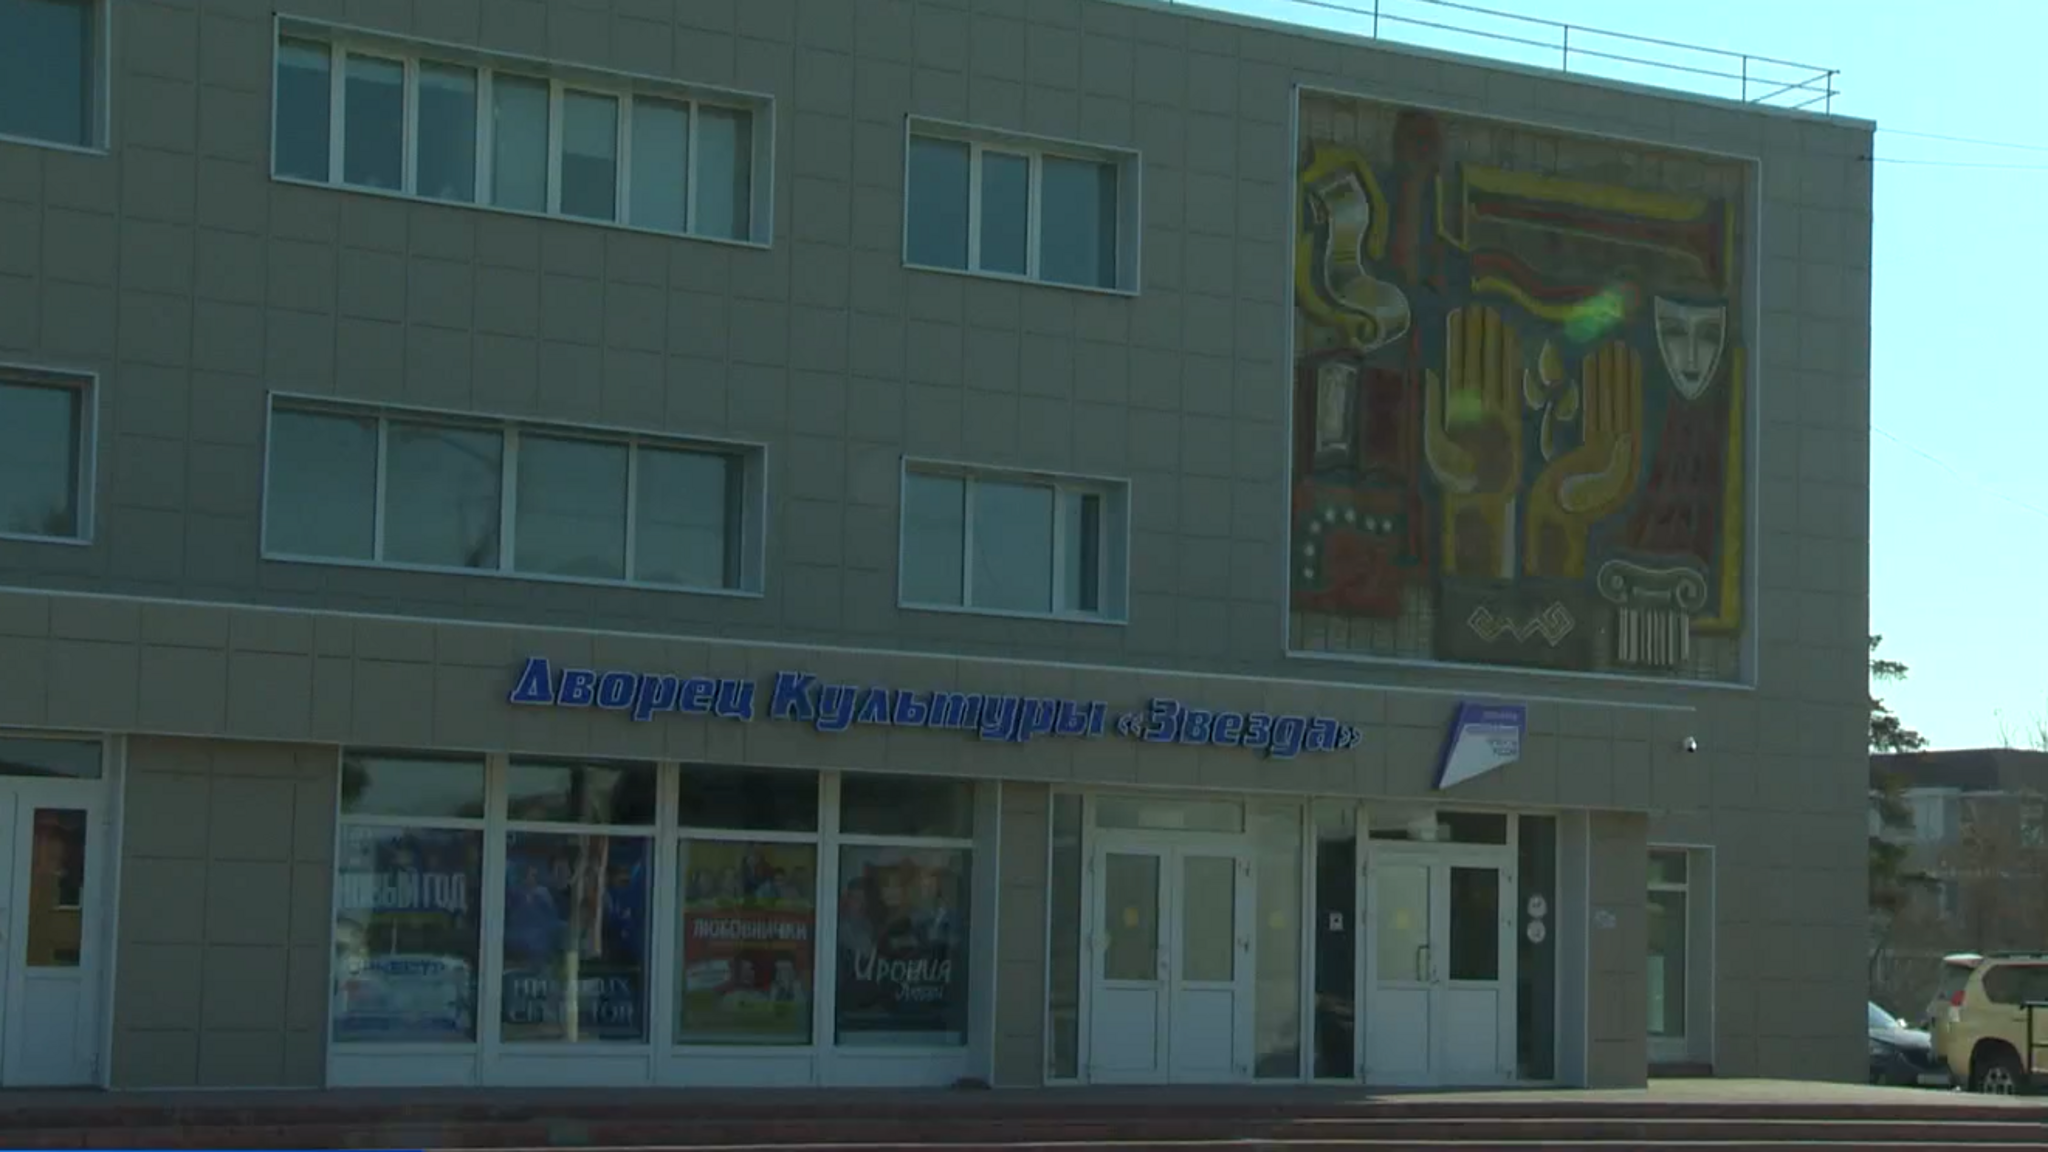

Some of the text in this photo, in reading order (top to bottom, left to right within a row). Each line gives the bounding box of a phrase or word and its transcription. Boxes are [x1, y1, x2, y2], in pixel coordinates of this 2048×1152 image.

[510, 656, 1362, 758] Дворец Культуры «Звезда»
